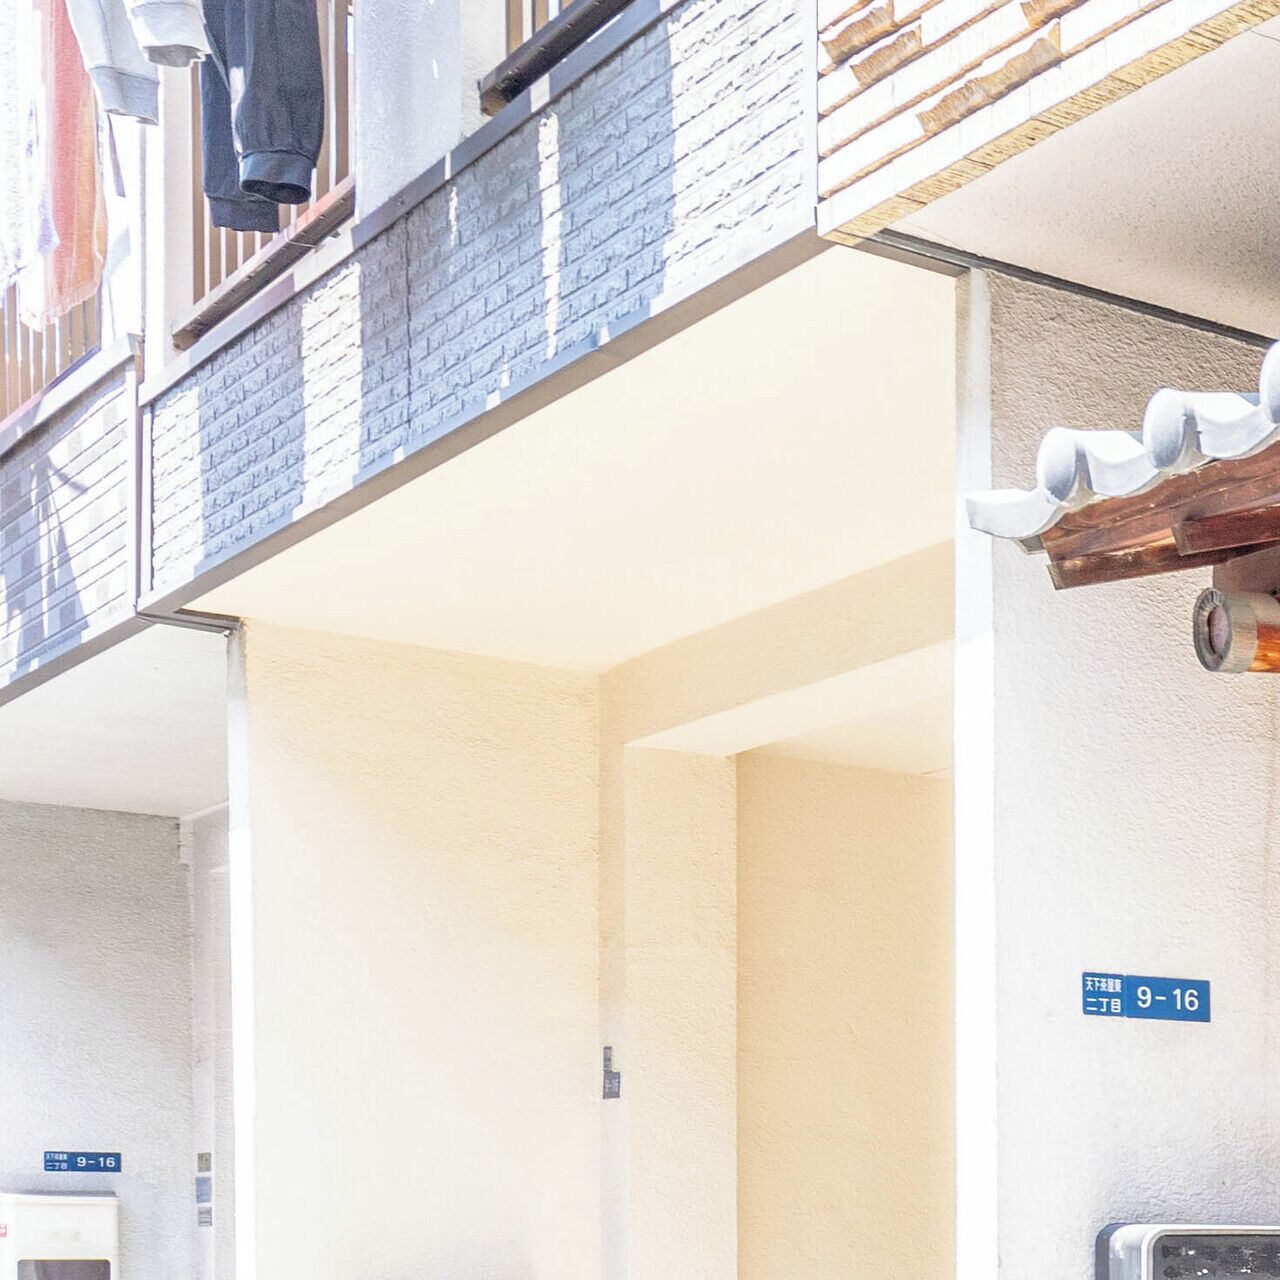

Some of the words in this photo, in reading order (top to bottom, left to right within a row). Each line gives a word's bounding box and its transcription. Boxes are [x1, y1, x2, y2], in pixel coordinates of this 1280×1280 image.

[1086, 997, 1121, 1013] 二丁目
[1136, 985, 1199, 1011] 9-16
[76, 1156, 115, 1168] 9-16
